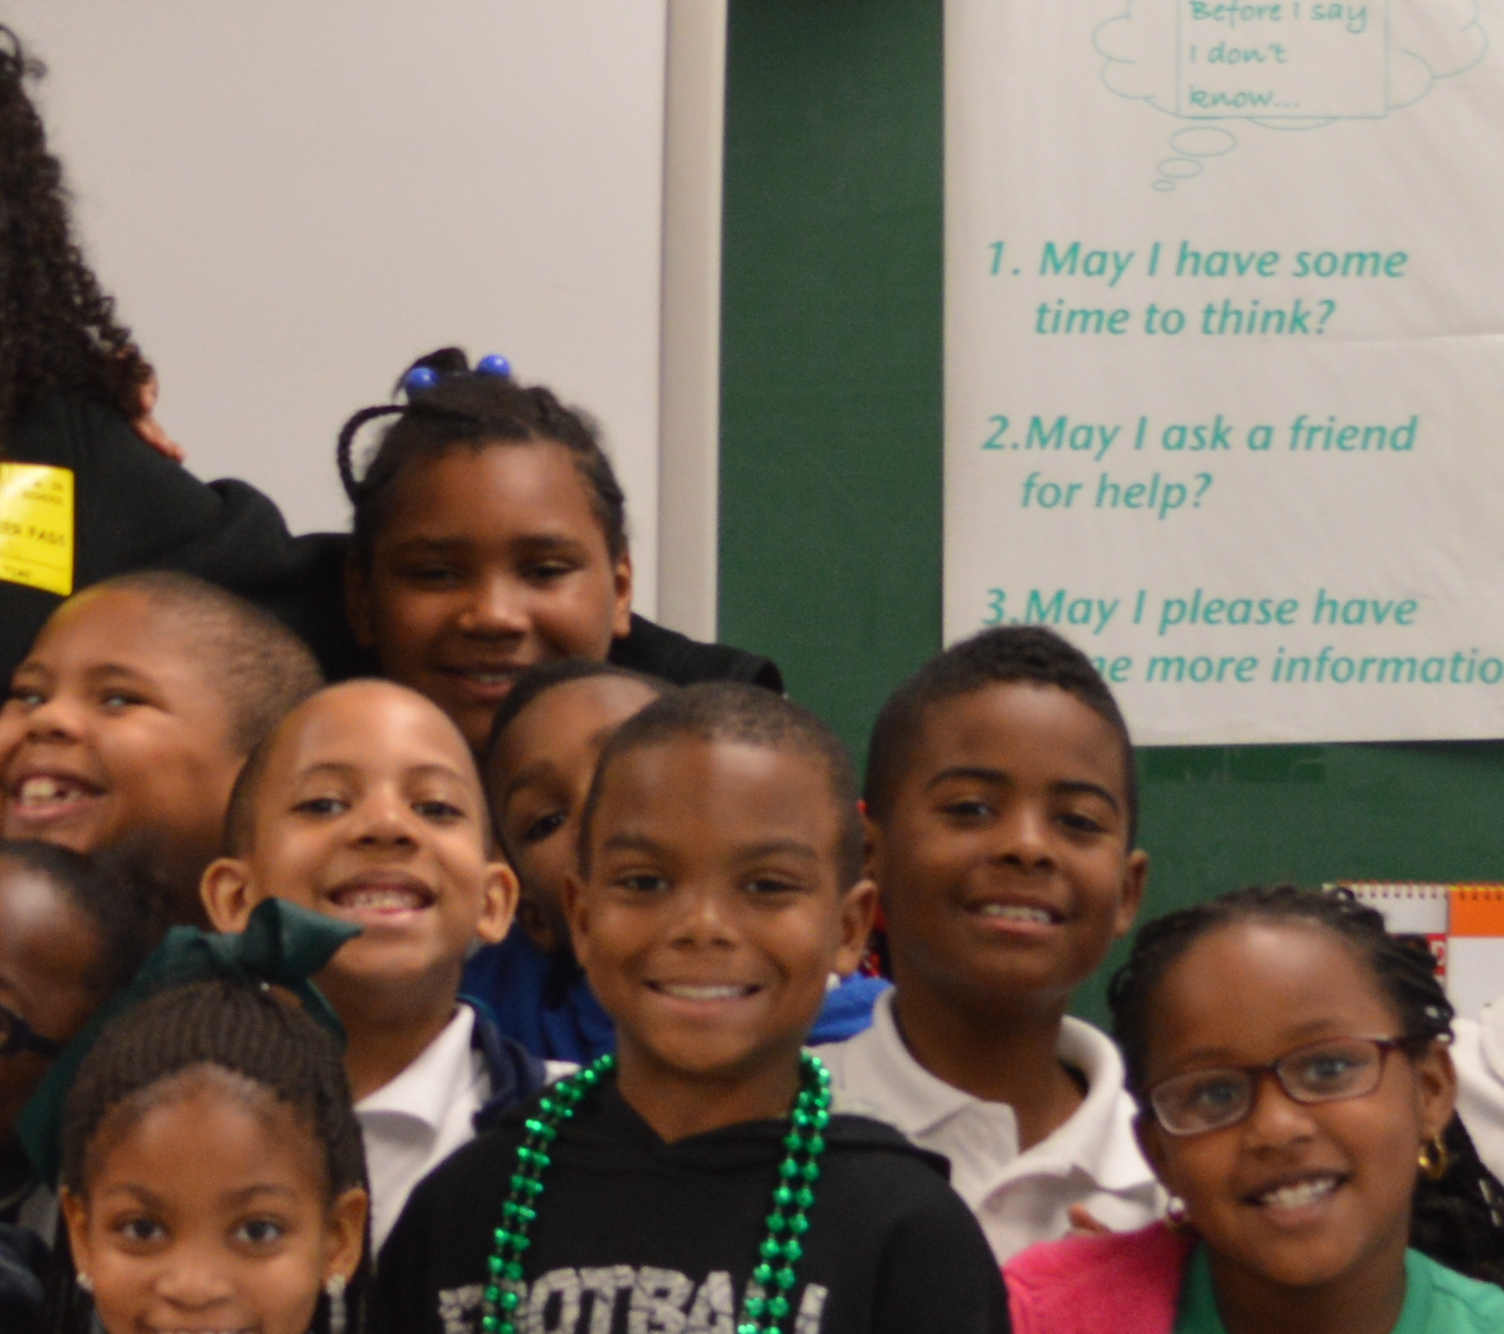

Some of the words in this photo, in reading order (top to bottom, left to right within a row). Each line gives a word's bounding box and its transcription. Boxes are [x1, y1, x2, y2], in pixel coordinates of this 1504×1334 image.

[1311, 2, 1368, 34] say
[1207, 41, 1286, 65] don't
[1039, 241, 1134, 287] May
[1176, 240, 1280, 277] have
[1292, 251, 1408, 278] some
[1035, 299, 1130, 335] time
[1144, 303, 1186, 335] to
[1202, 299, 1336, 335] think?
[1162, 414, 1232, 451] ask
[1247, 425, 1274, 451] a
[1289, 415, 1419, 452] friend
[1021, 472, 1083, 509] for
[1095, 472, 1213, 520] help?
[1158, 588, 1299, 636] please
[1313, 588, 1418, 626] have
[1146, 656, 1259, 683] more
